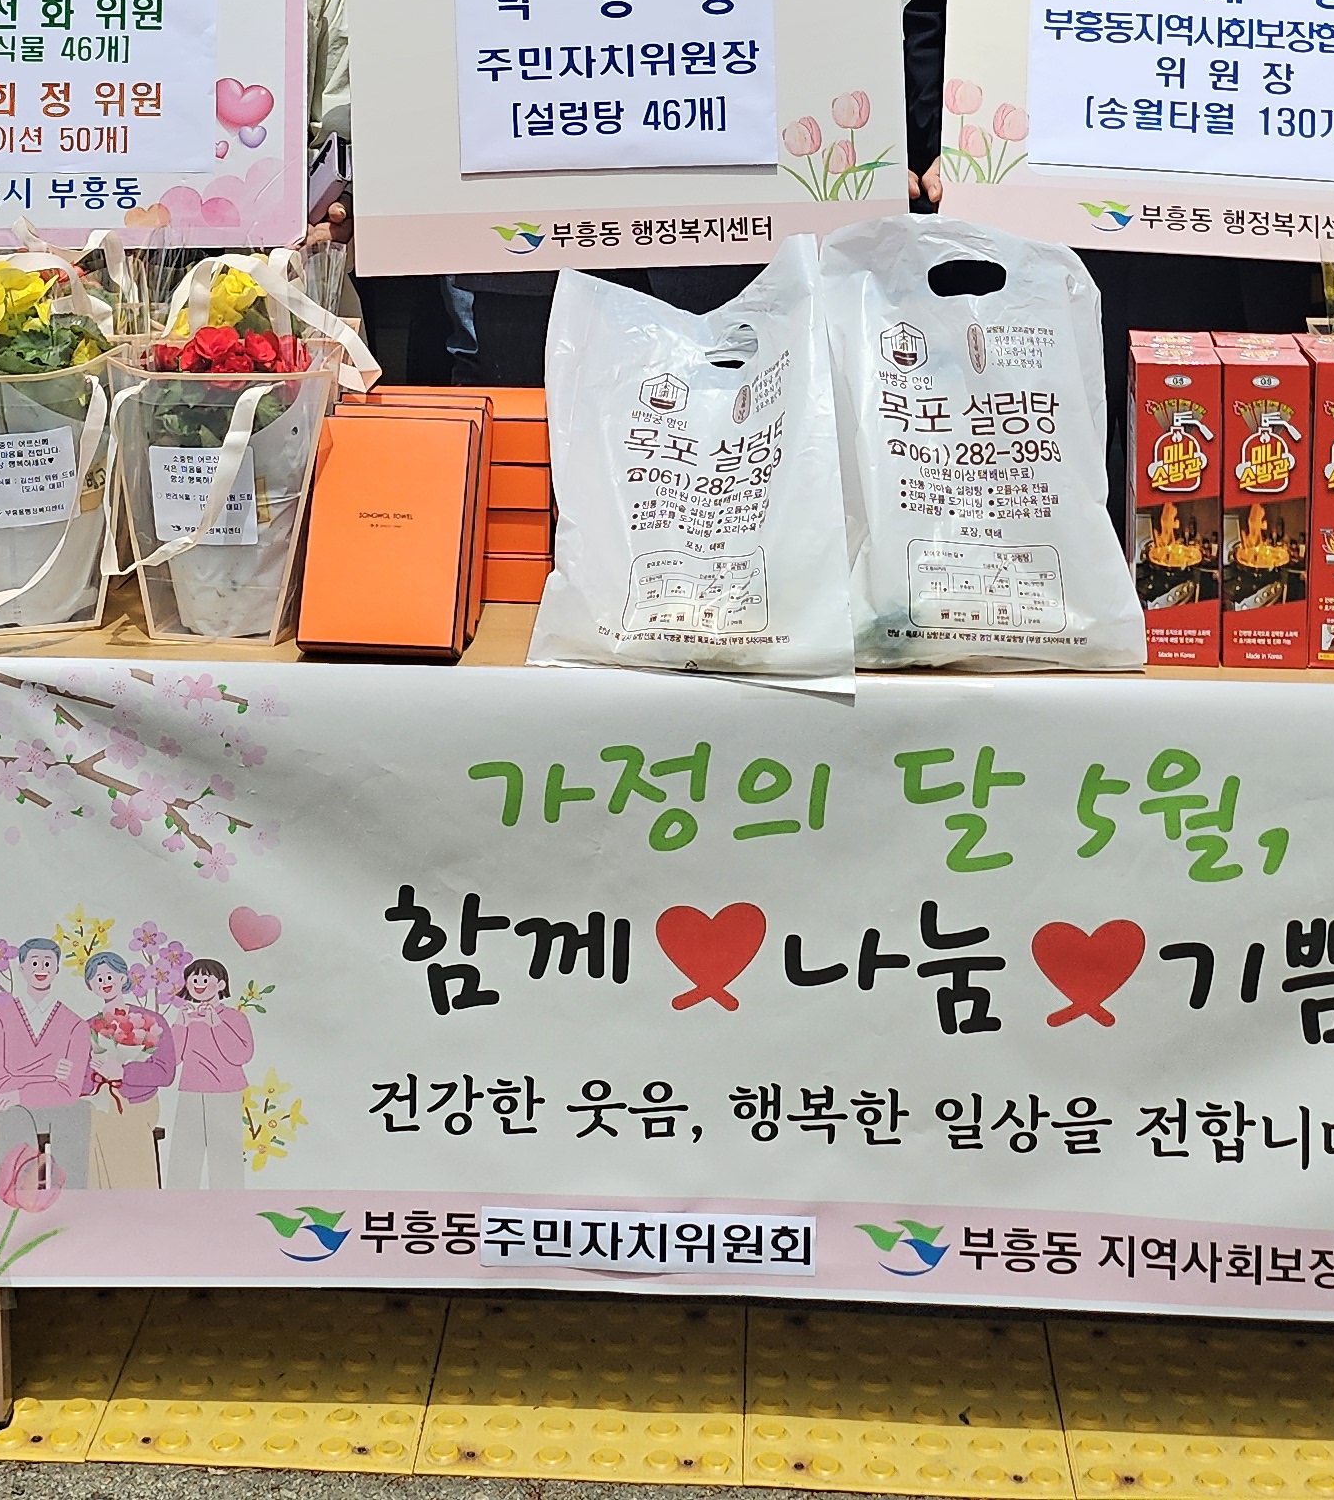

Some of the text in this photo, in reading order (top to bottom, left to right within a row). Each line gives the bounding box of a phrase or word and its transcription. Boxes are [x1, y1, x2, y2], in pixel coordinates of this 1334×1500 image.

[60, 34, 130, 64] 46개]
[476, 40, 760, 83] 주민자치위원장
[40, 81, 73, 117] 정
[94, 81, 163, 117] 위원
[1085, 95, 1235, 135] [송월타월
[512, 96, 727, 138] [설렁탕 46개]
[59, 124, 129, 155] 50개]
[48, 176, 142, 210] 부흥동
[551, 216, 773, 250] 부흥동 행정복지센터
[1139, 204, 1212, 232] 부흥동
[879, 391, 1059, 436] 목포 설렁탕
[624, 428, 699, 466] 목포
[955, 440, 1062, 466] 282-3959
[1163, 441, 1194, 464] 미니
[1251, 441, 1282, 464] 미니
[1151, 458, 1201, 488] 소방관
[1239, 458, 1289, 488] 소방관
[467, 740, 1290, 884] 가정의 달 5월,
[384, 884, 631, 1017] 함께
[783, 900, 1006, 1035] 나눔
[368, 1072, 545, 1136] 건강한
[568, 1079, 704, 1145] 웃음,
[731, 1085, 910, 1148] 행복한
[934, 1092, 1113, 1155] 일상을
[958, 1225, 1083, 1276] 부흥동
